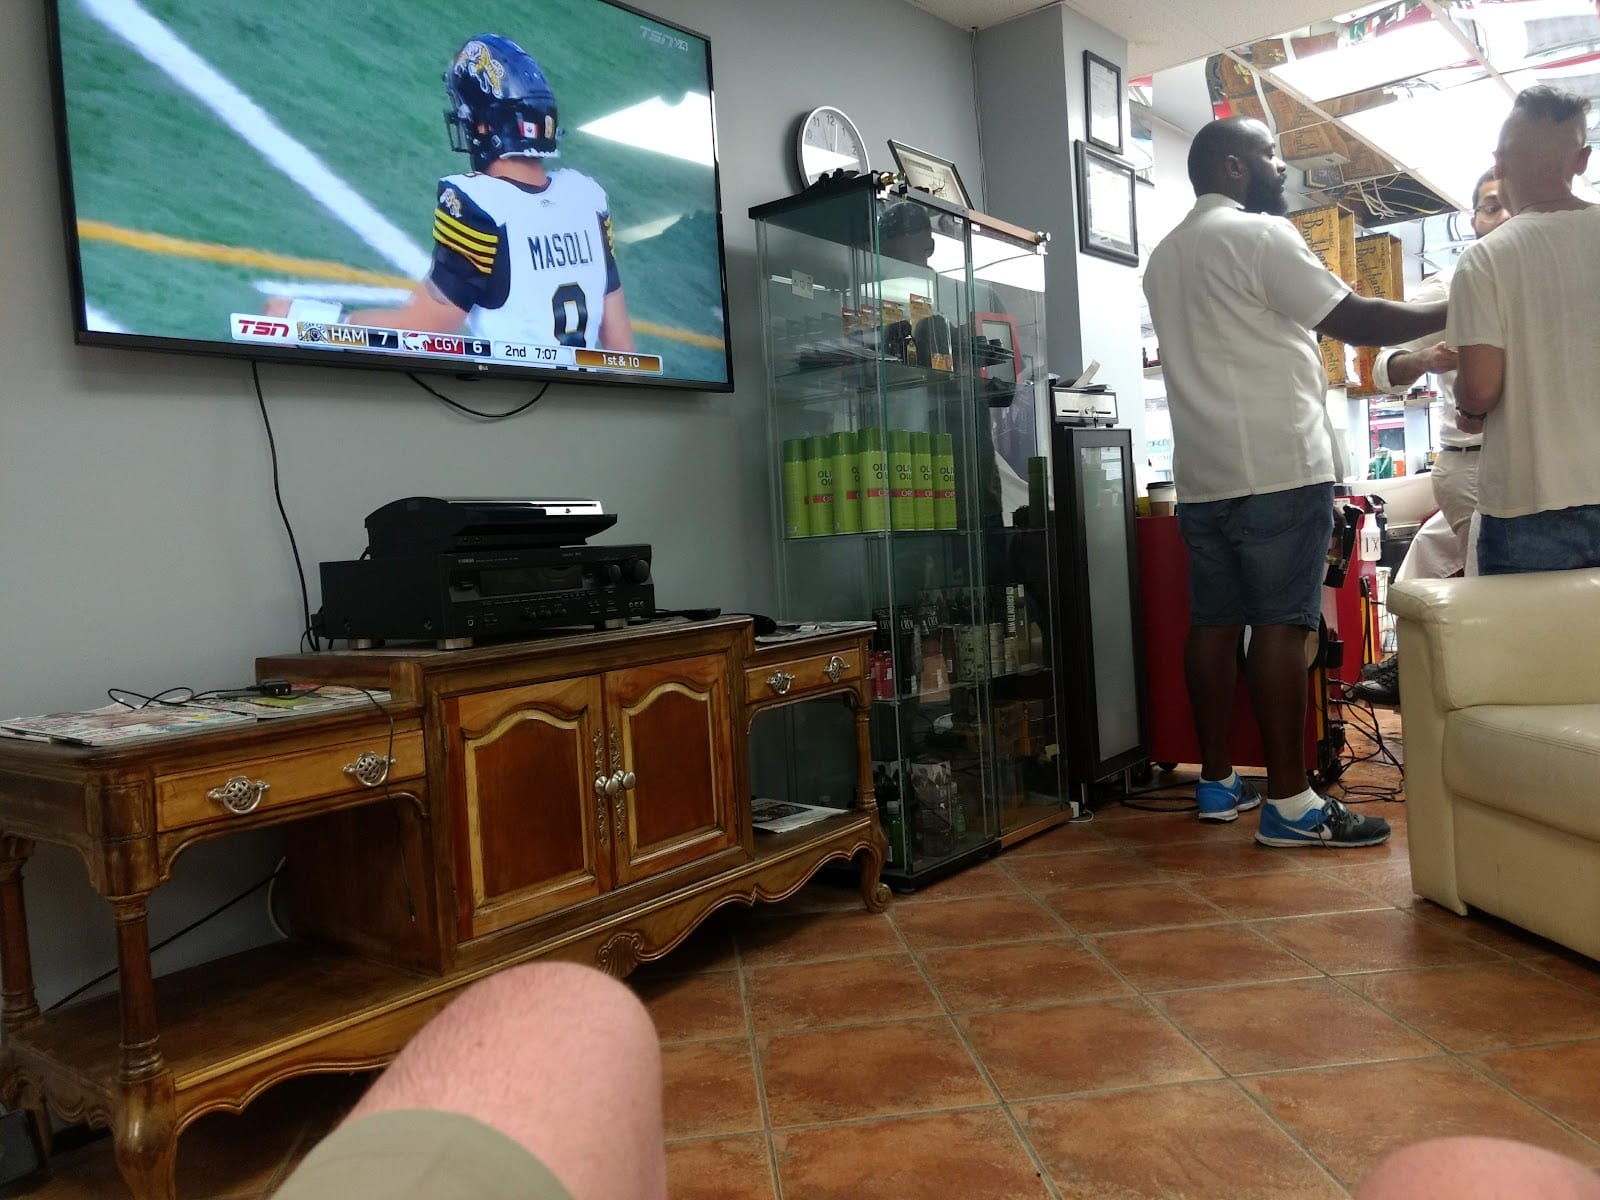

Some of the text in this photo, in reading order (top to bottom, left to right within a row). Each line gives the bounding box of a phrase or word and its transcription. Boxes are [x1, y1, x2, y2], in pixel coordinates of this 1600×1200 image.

[812, 116, 820, 128] 11
[826, 114, 835, 127] 12
[527, 229, 593, 271] MASOLI
[238, 319, 290, 338] TSN
[331, 327, 365, 343] HAM
[377, 331, 388, 345] 7
[434, 337, 483, 354] CGY 6
[505, 345, 558, 360] 2nd 7:07
[602, 353, 640, 368] 1st & 10
